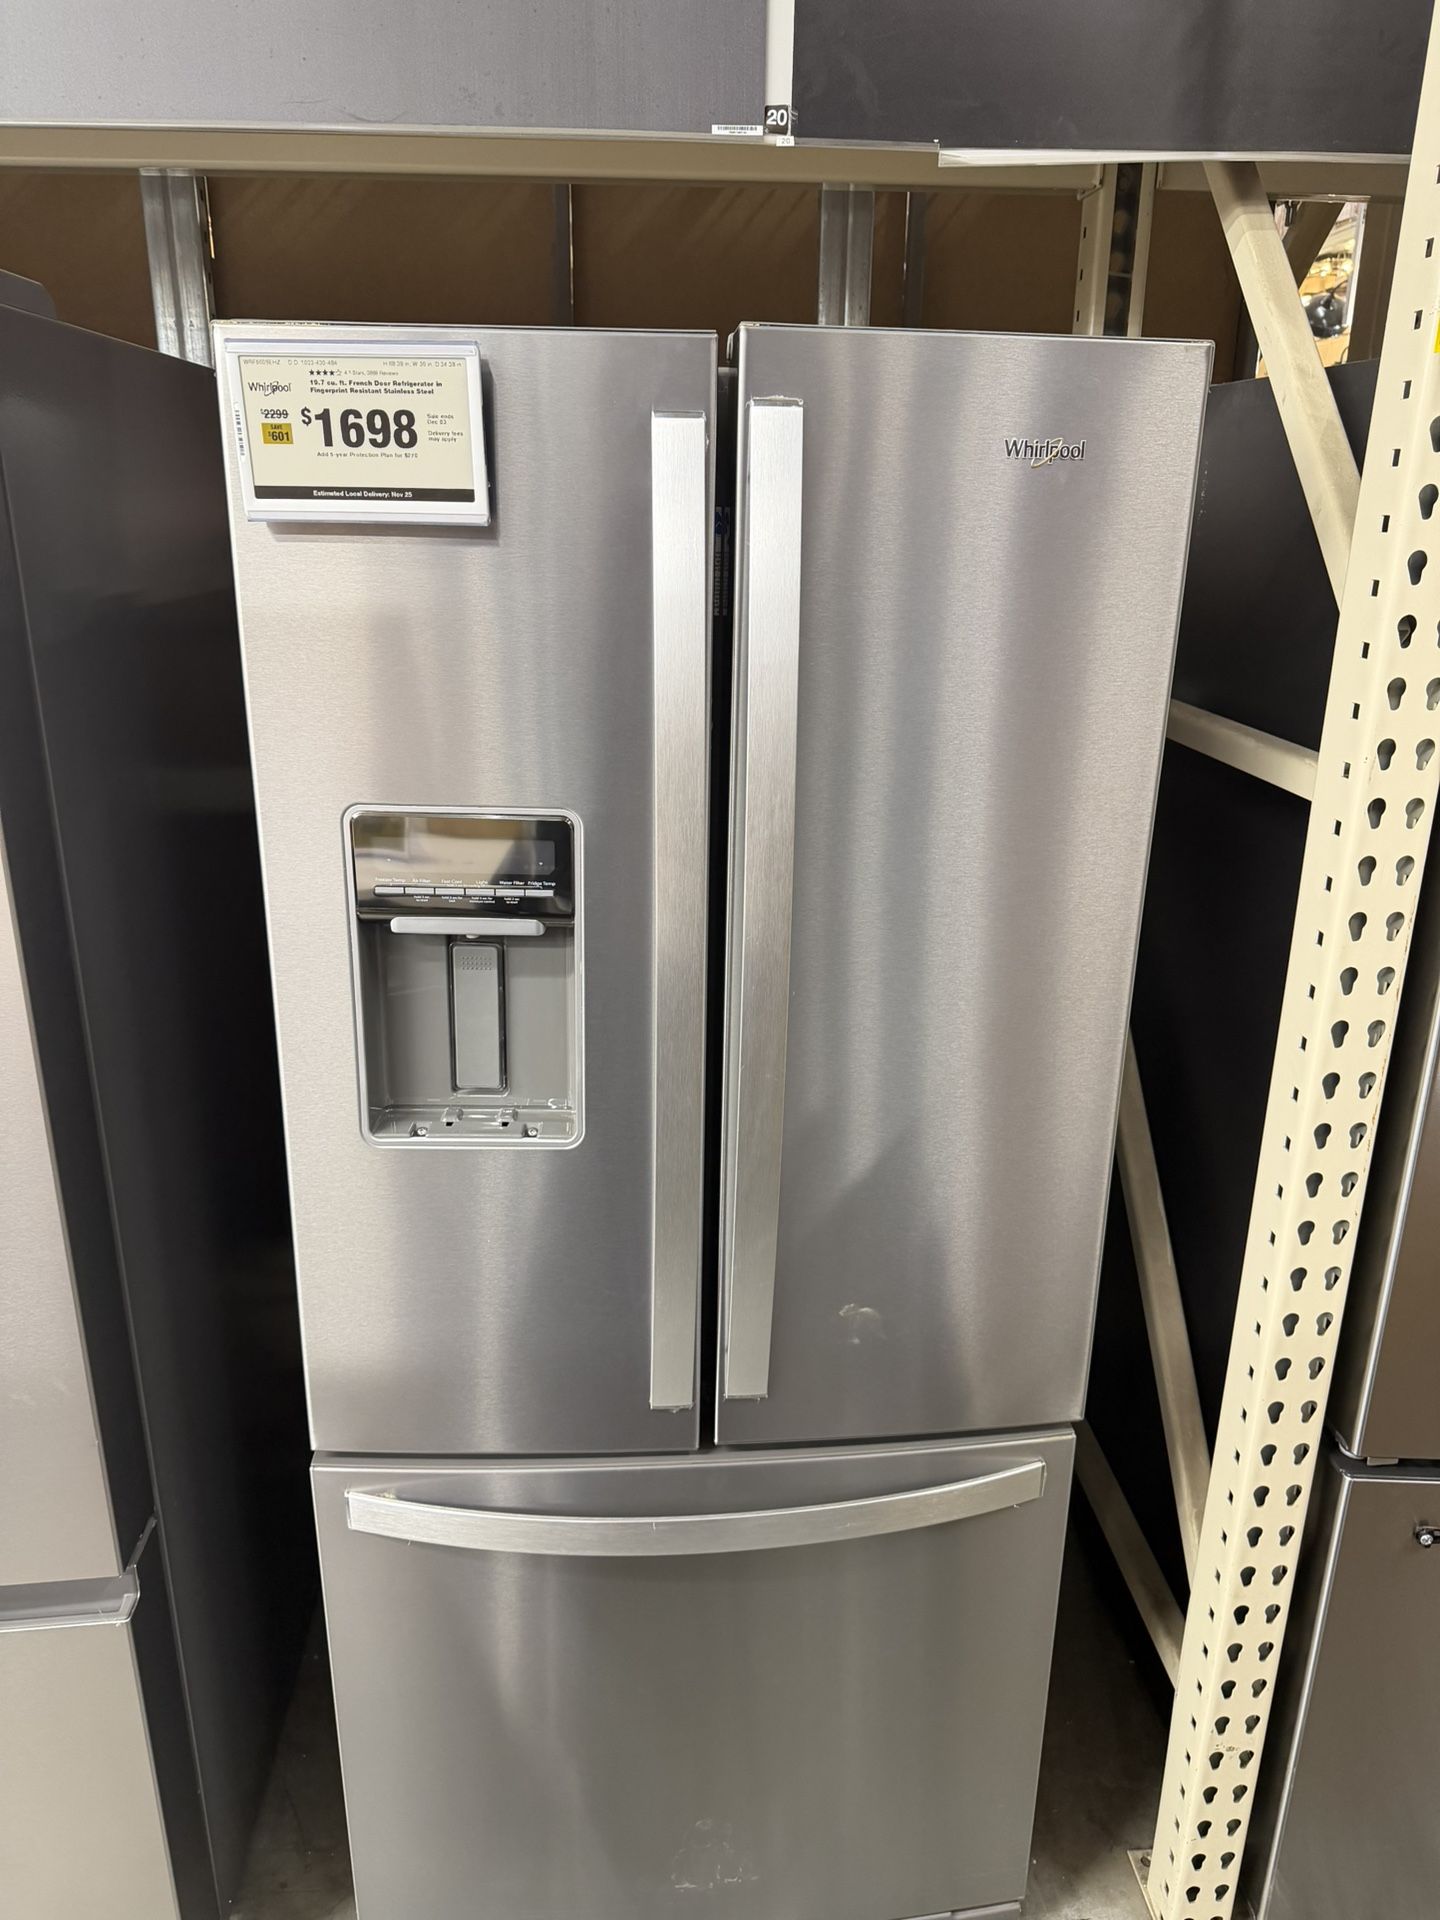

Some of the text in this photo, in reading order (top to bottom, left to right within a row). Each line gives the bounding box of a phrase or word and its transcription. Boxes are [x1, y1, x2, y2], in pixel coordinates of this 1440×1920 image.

[766, 108, 788, 126] 20
[248, 381, 292, 396] Whirlpool
[260, 408, 289, 419] $2299
[300, 406, 418, 449] $1698
[268, 431, 290, 442] $601
[1004, 437, 1086, 468] Whirlpool
